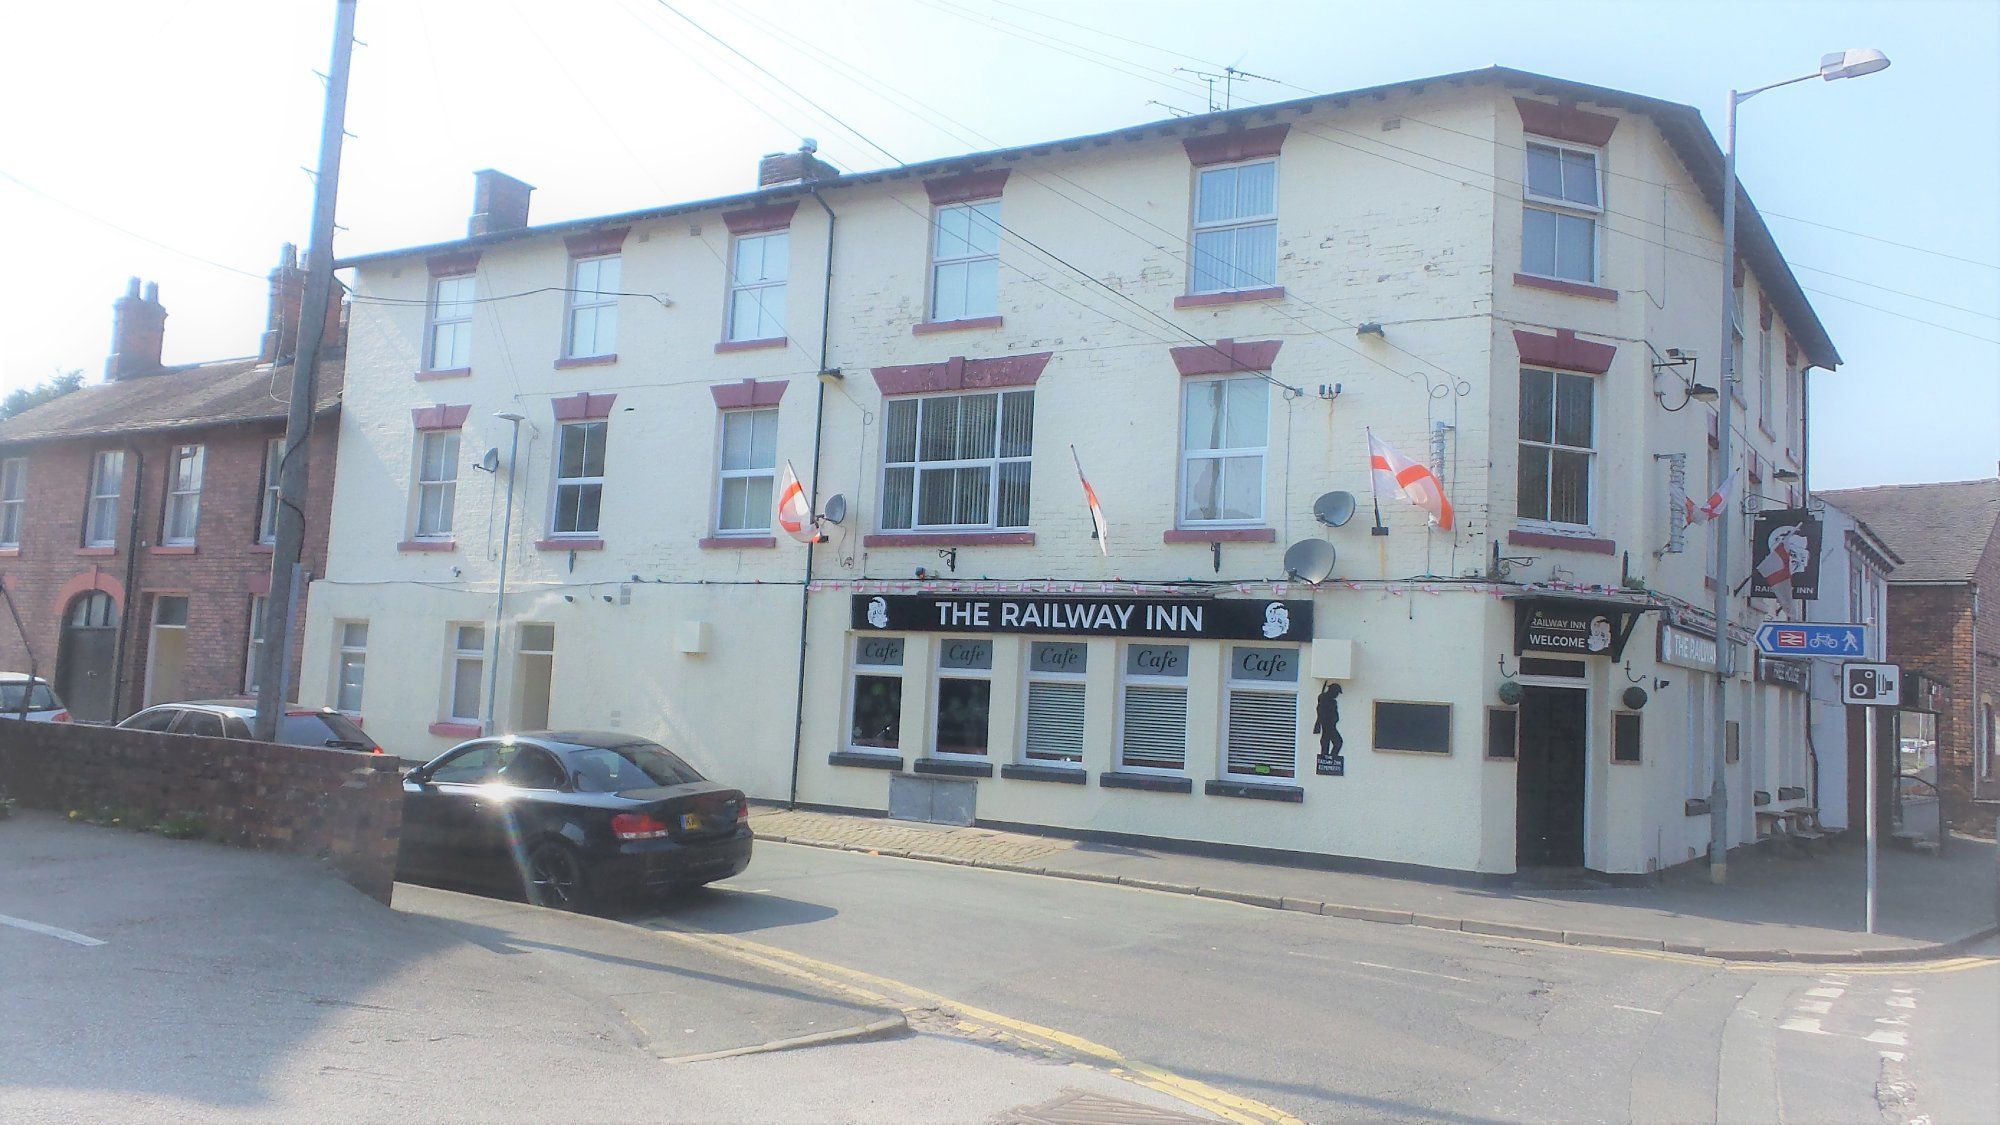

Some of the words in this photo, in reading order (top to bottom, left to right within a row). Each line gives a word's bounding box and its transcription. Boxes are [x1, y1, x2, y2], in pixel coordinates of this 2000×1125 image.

[1796, 586, 1814, 594] INN
[935, 601, 989, 627] THE
[1001, 602, 1135, 629] RAILWAY
[1146, 604, 1203, 632] INN
[1531, 617, 1569, 628] RAILWAY
[1570, 620, 1586, 629] INN
[865, 641, 899, 662] Cafe
[1529, 633, 1586, 648] WELCOME
[1674, 634, 1689, 658] THE
[949, 642, 985, 666] Cafe
[1040, 646, 1078, 669] Cafe
[1137, 649, 1178, 673] Cafe
[1242, 652, 1287, 677] Cafe
